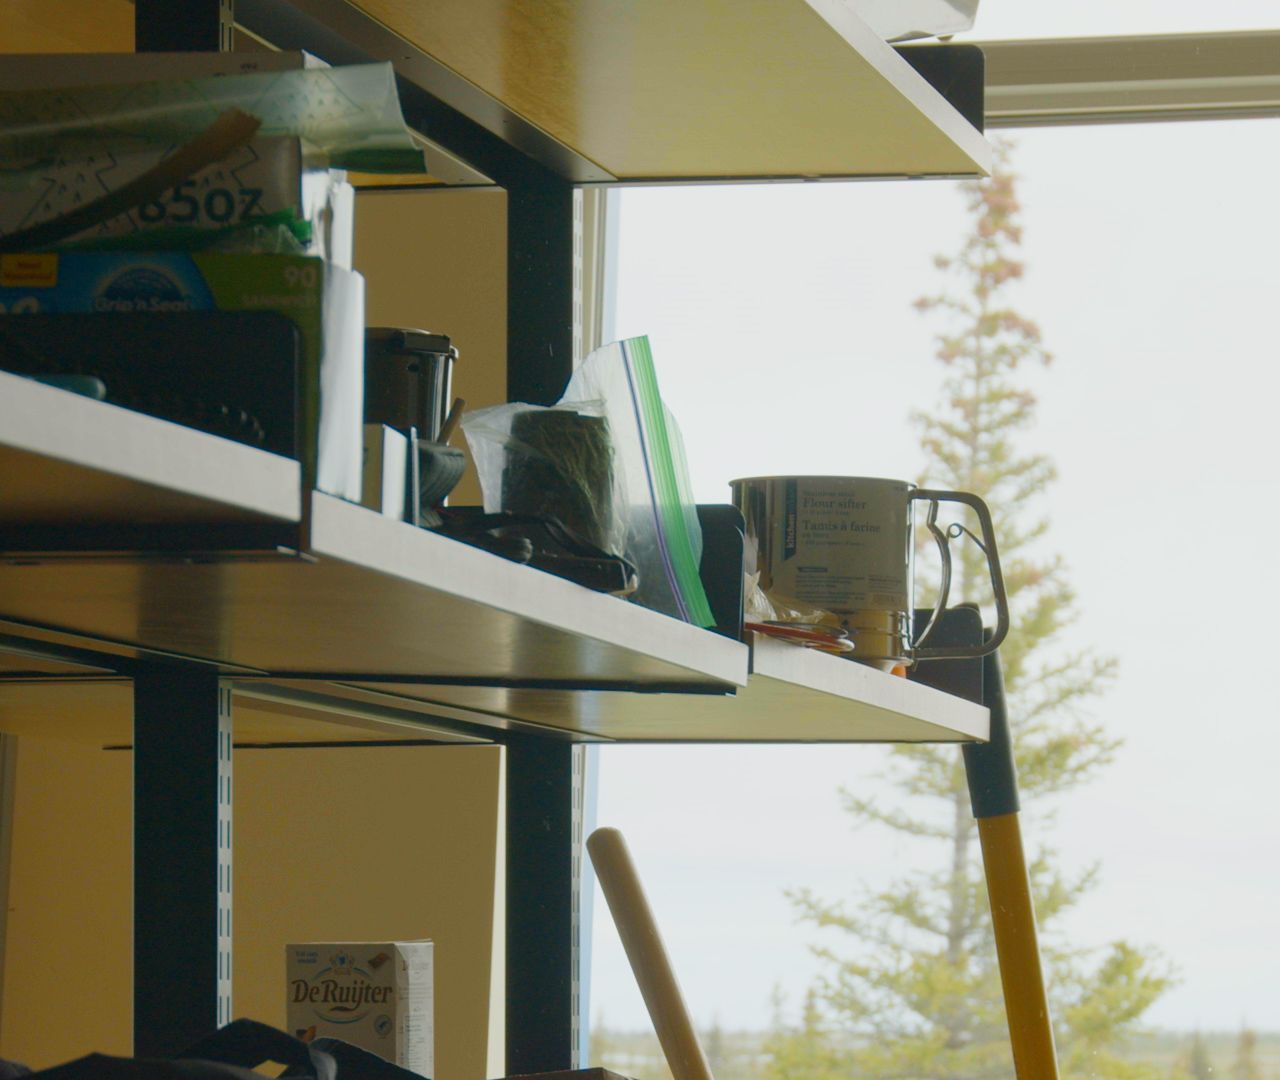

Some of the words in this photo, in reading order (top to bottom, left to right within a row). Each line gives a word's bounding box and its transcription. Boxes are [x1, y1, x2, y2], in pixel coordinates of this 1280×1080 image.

[803, 498, 832, 508] Flour
[838, 498, 866, 509] sifter
[802, 520, 836, 530] Tamis
[291, 978, 320, 1004] De
[320, 978, 393, 1012] Ruijter
